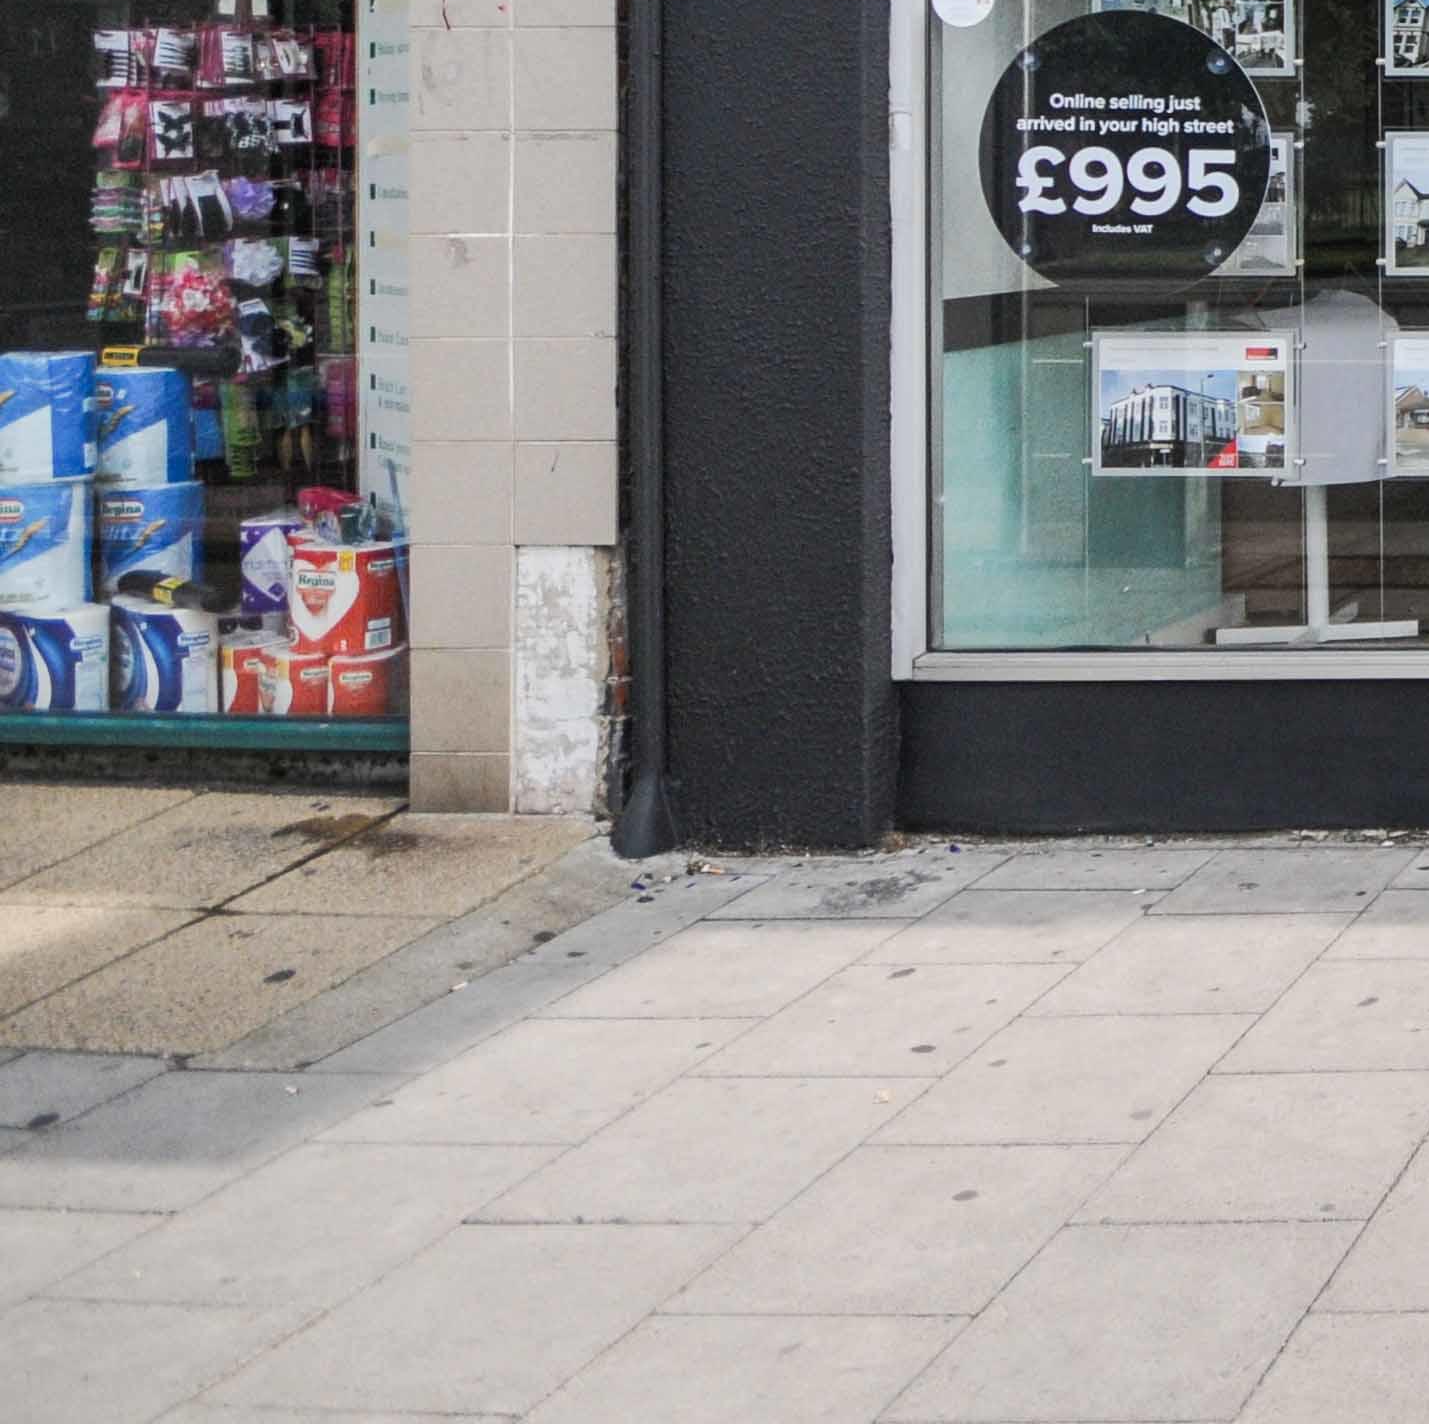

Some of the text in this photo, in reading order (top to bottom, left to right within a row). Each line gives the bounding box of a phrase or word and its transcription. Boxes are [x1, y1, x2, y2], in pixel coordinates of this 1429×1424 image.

[1050, 93, 1202, 114] Online selling just
[1016, 116, 1234, 136] arrived in your high street
[1015, 145, 1240, 217] £995
[1092, 224, 1154, 234] Includes VAT
[298, 575, 336, 587] Regina
